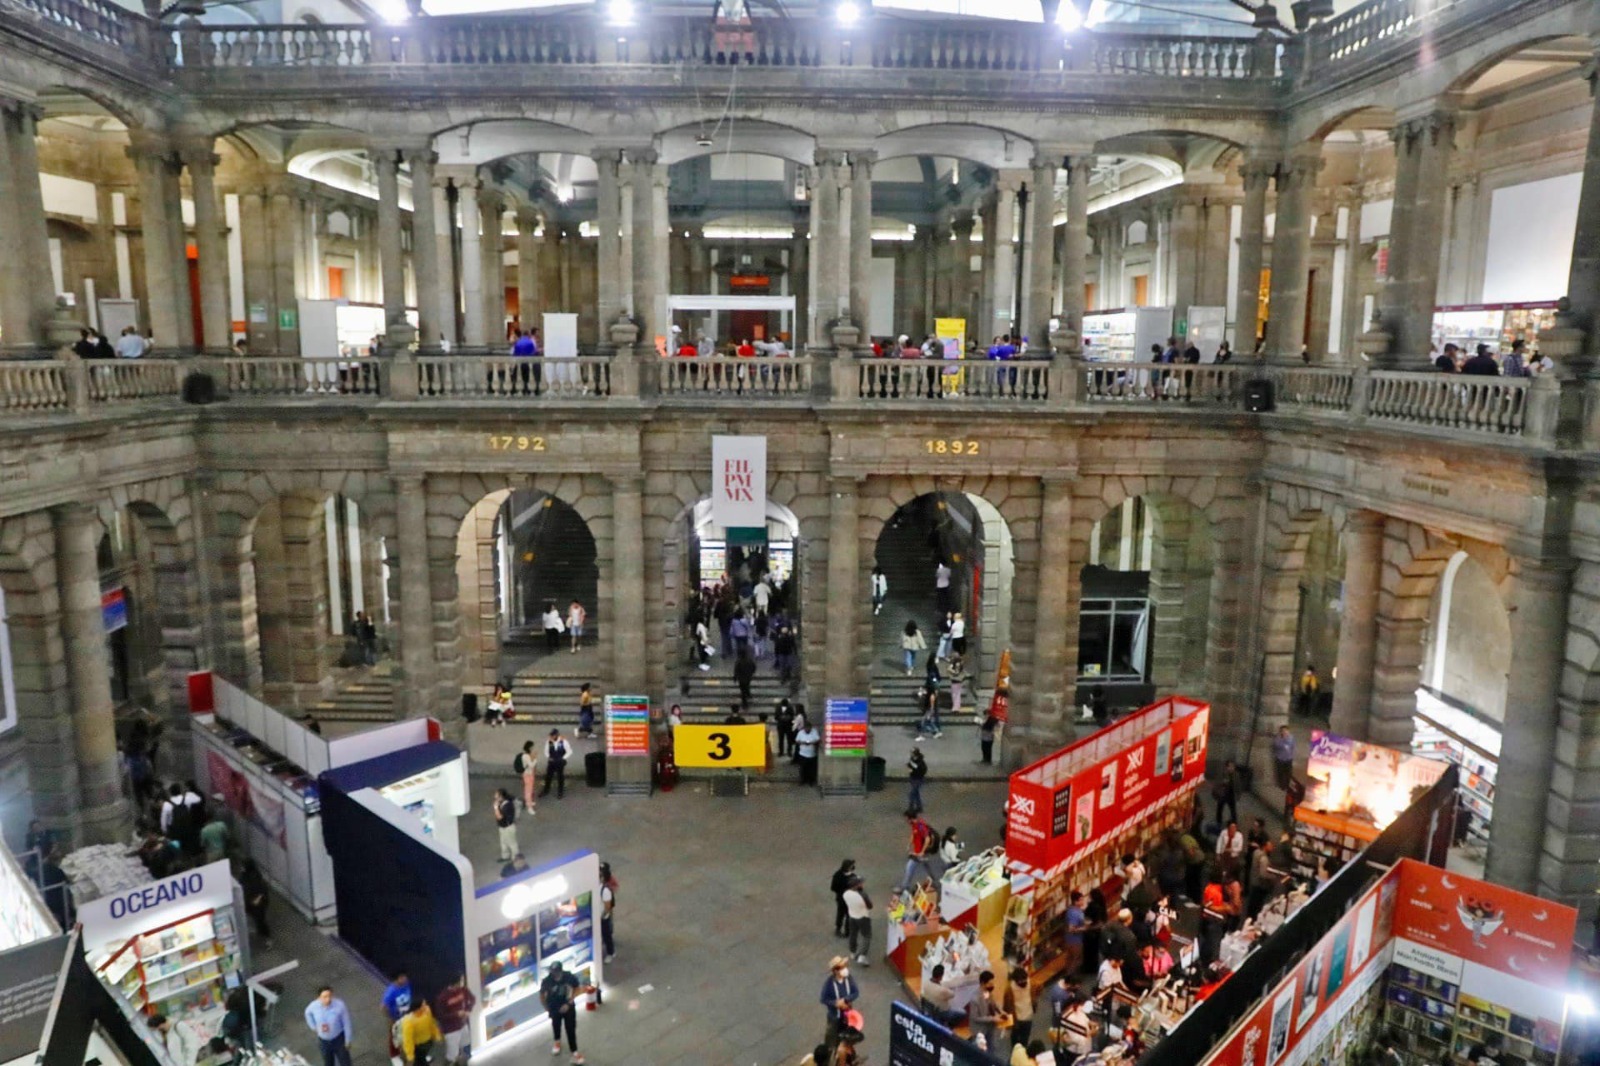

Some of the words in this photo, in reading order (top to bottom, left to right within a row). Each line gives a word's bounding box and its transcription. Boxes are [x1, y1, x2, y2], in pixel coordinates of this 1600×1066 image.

[490, 436, 545, 451] 1792
[926, 440, 979, 455] 1892
[725, 459, 753, 473] FIL
[725, 474, 751, 488] PM
[725, 488, 753, 502] MX
[707, 732, 732, 761] 3
[110, 873, 203, 919] OCEANO
[894, 1013, 923, 1036] esta
[905, 1028, 935, 1054] vida
